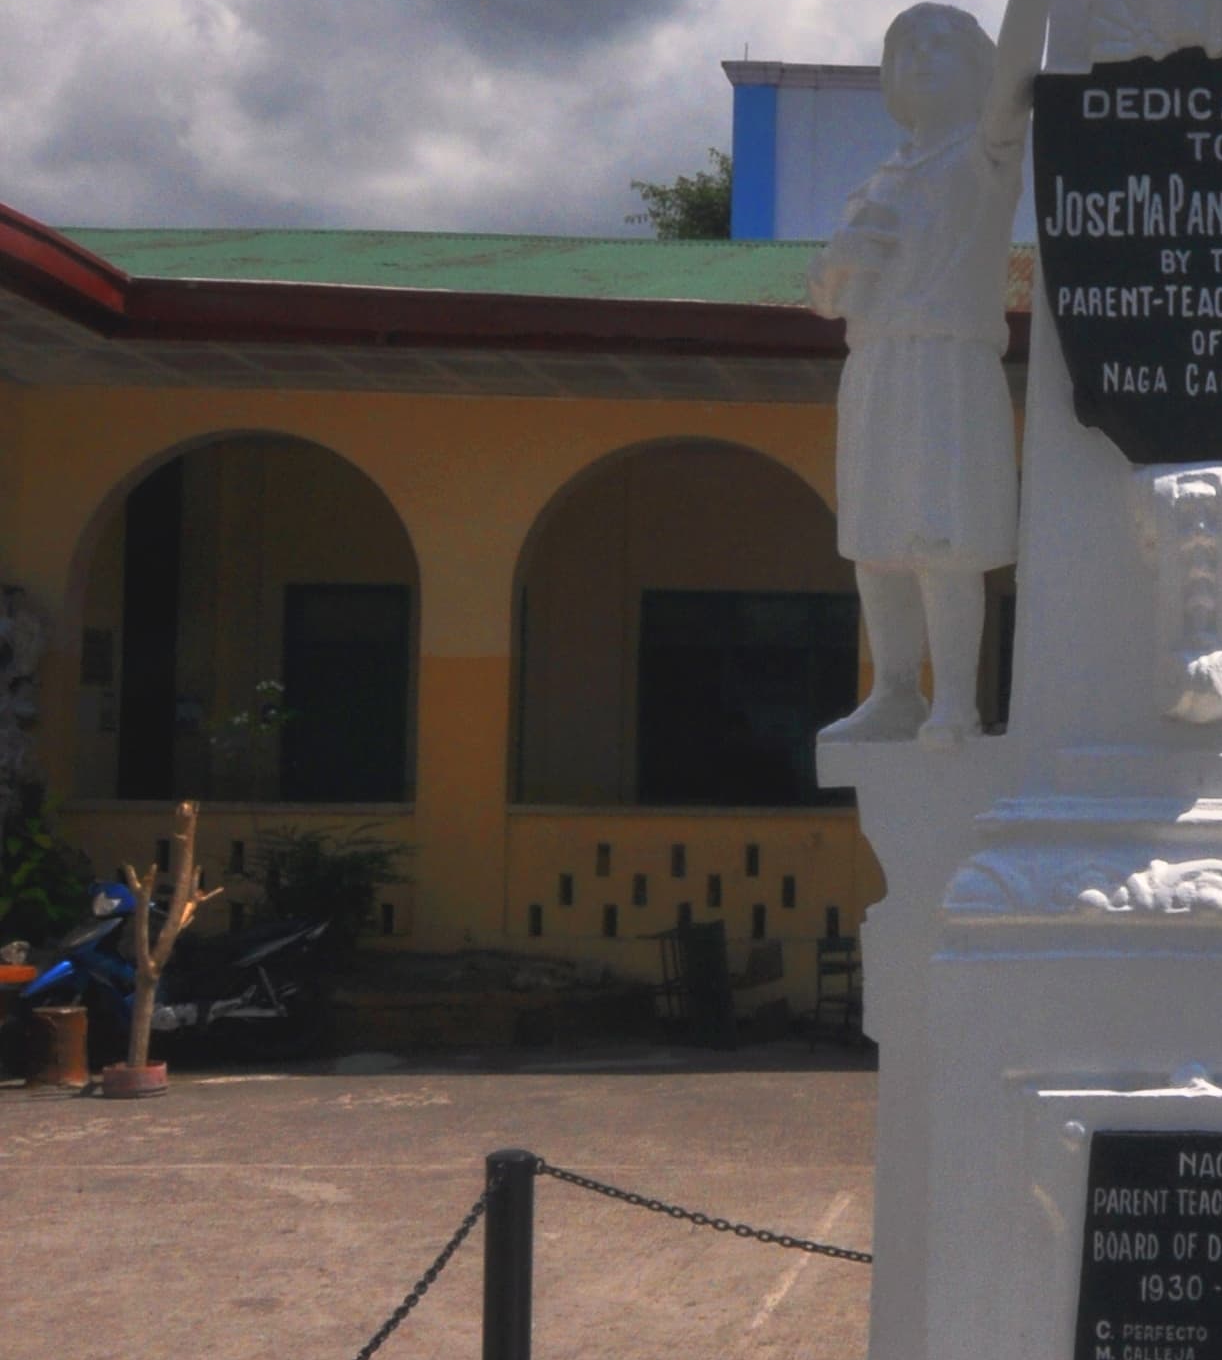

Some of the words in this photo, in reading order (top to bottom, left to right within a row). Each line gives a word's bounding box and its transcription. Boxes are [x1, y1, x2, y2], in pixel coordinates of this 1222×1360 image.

[1161, 250, 1191, 273] BY
[1192, 330, 1222, 356] OF
[1103, 364, 1167, 394] NAGA
[1094, 1188, 1168, 1216] PARENT
[1094, 1231, 1158, 1262] BOARD
[1173, 1233, 1198, 1260] OF
[1140, 1275, 1202, 1302] 1930
[1096, 1320, 1114, 1340] C.
[1123, 1325, 1207, 1342] PERFECTO
[1096, 1346, 1115, 1360] M.
